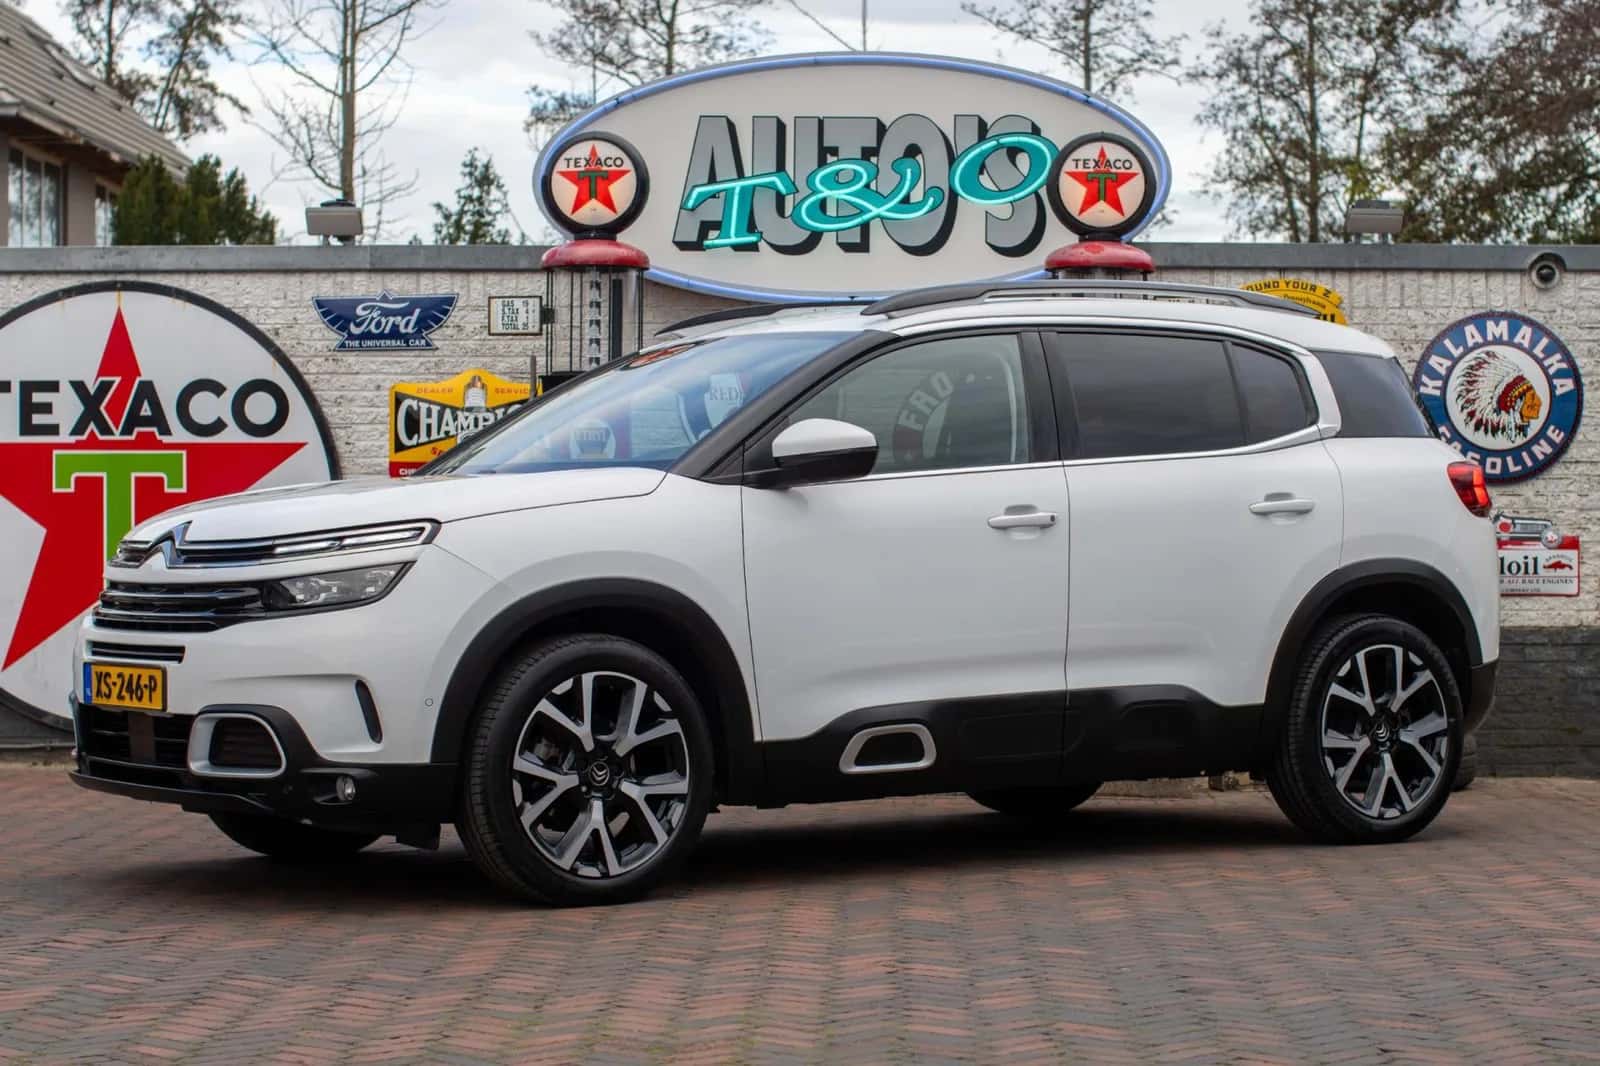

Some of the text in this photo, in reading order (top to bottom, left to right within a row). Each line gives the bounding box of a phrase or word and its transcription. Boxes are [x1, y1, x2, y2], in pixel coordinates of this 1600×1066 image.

[564, 157, 624, 168] TEXACO
[1072, 159, 1133, 170] TEXACO
[672, 114, 1046, 257] AUTO'S
[1241, 281, 1280, 292] OUND
[1285, 280, 1316, 292] YOUR
[350, 301, 421, 334] Ford
[501, 322, 519, 330] TOTAL
[1420, 319, 1575, 396] KALAMALKA
[0, 378, 290, 438] EXACO
[397, 398, 523, 446] CHAMP
[95, 671, 157, 703] XS-246-P
